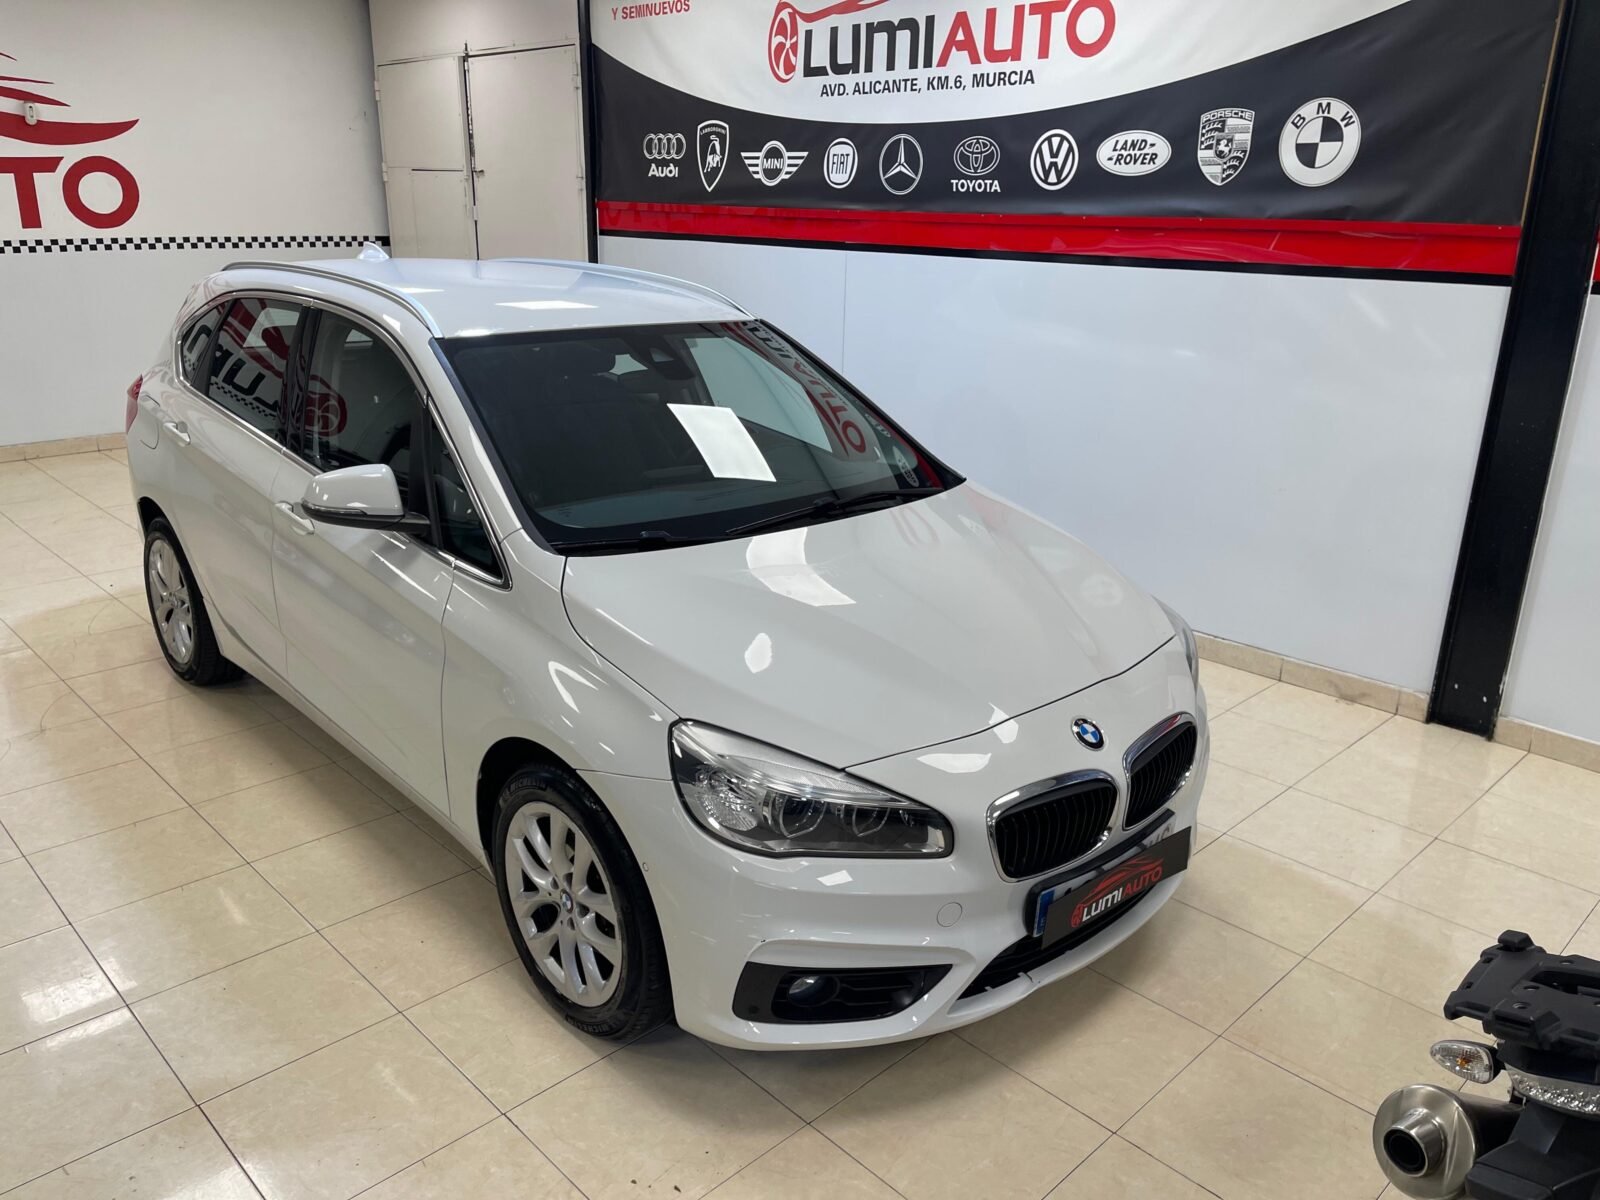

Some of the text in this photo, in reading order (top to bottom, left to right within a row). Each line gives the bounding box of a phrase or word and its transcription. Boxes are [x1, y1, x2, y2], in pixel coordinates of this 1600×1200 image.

[611, 0, 690, 20] Y SEMINUEVOS
[820, 69, 1035, 97] AVD. ALICANTE, KM.6, MURCIA
[1201, 109, 1253, 123] PORSCHE
[1290, 101, 1357, 130] BMW
[648, 162, 679, 178] Audi
[762, 157, 784, 170] MINI
[831, 152, 851, 175] FIAT
[950, 179, 1001, 193] TOYOTA
